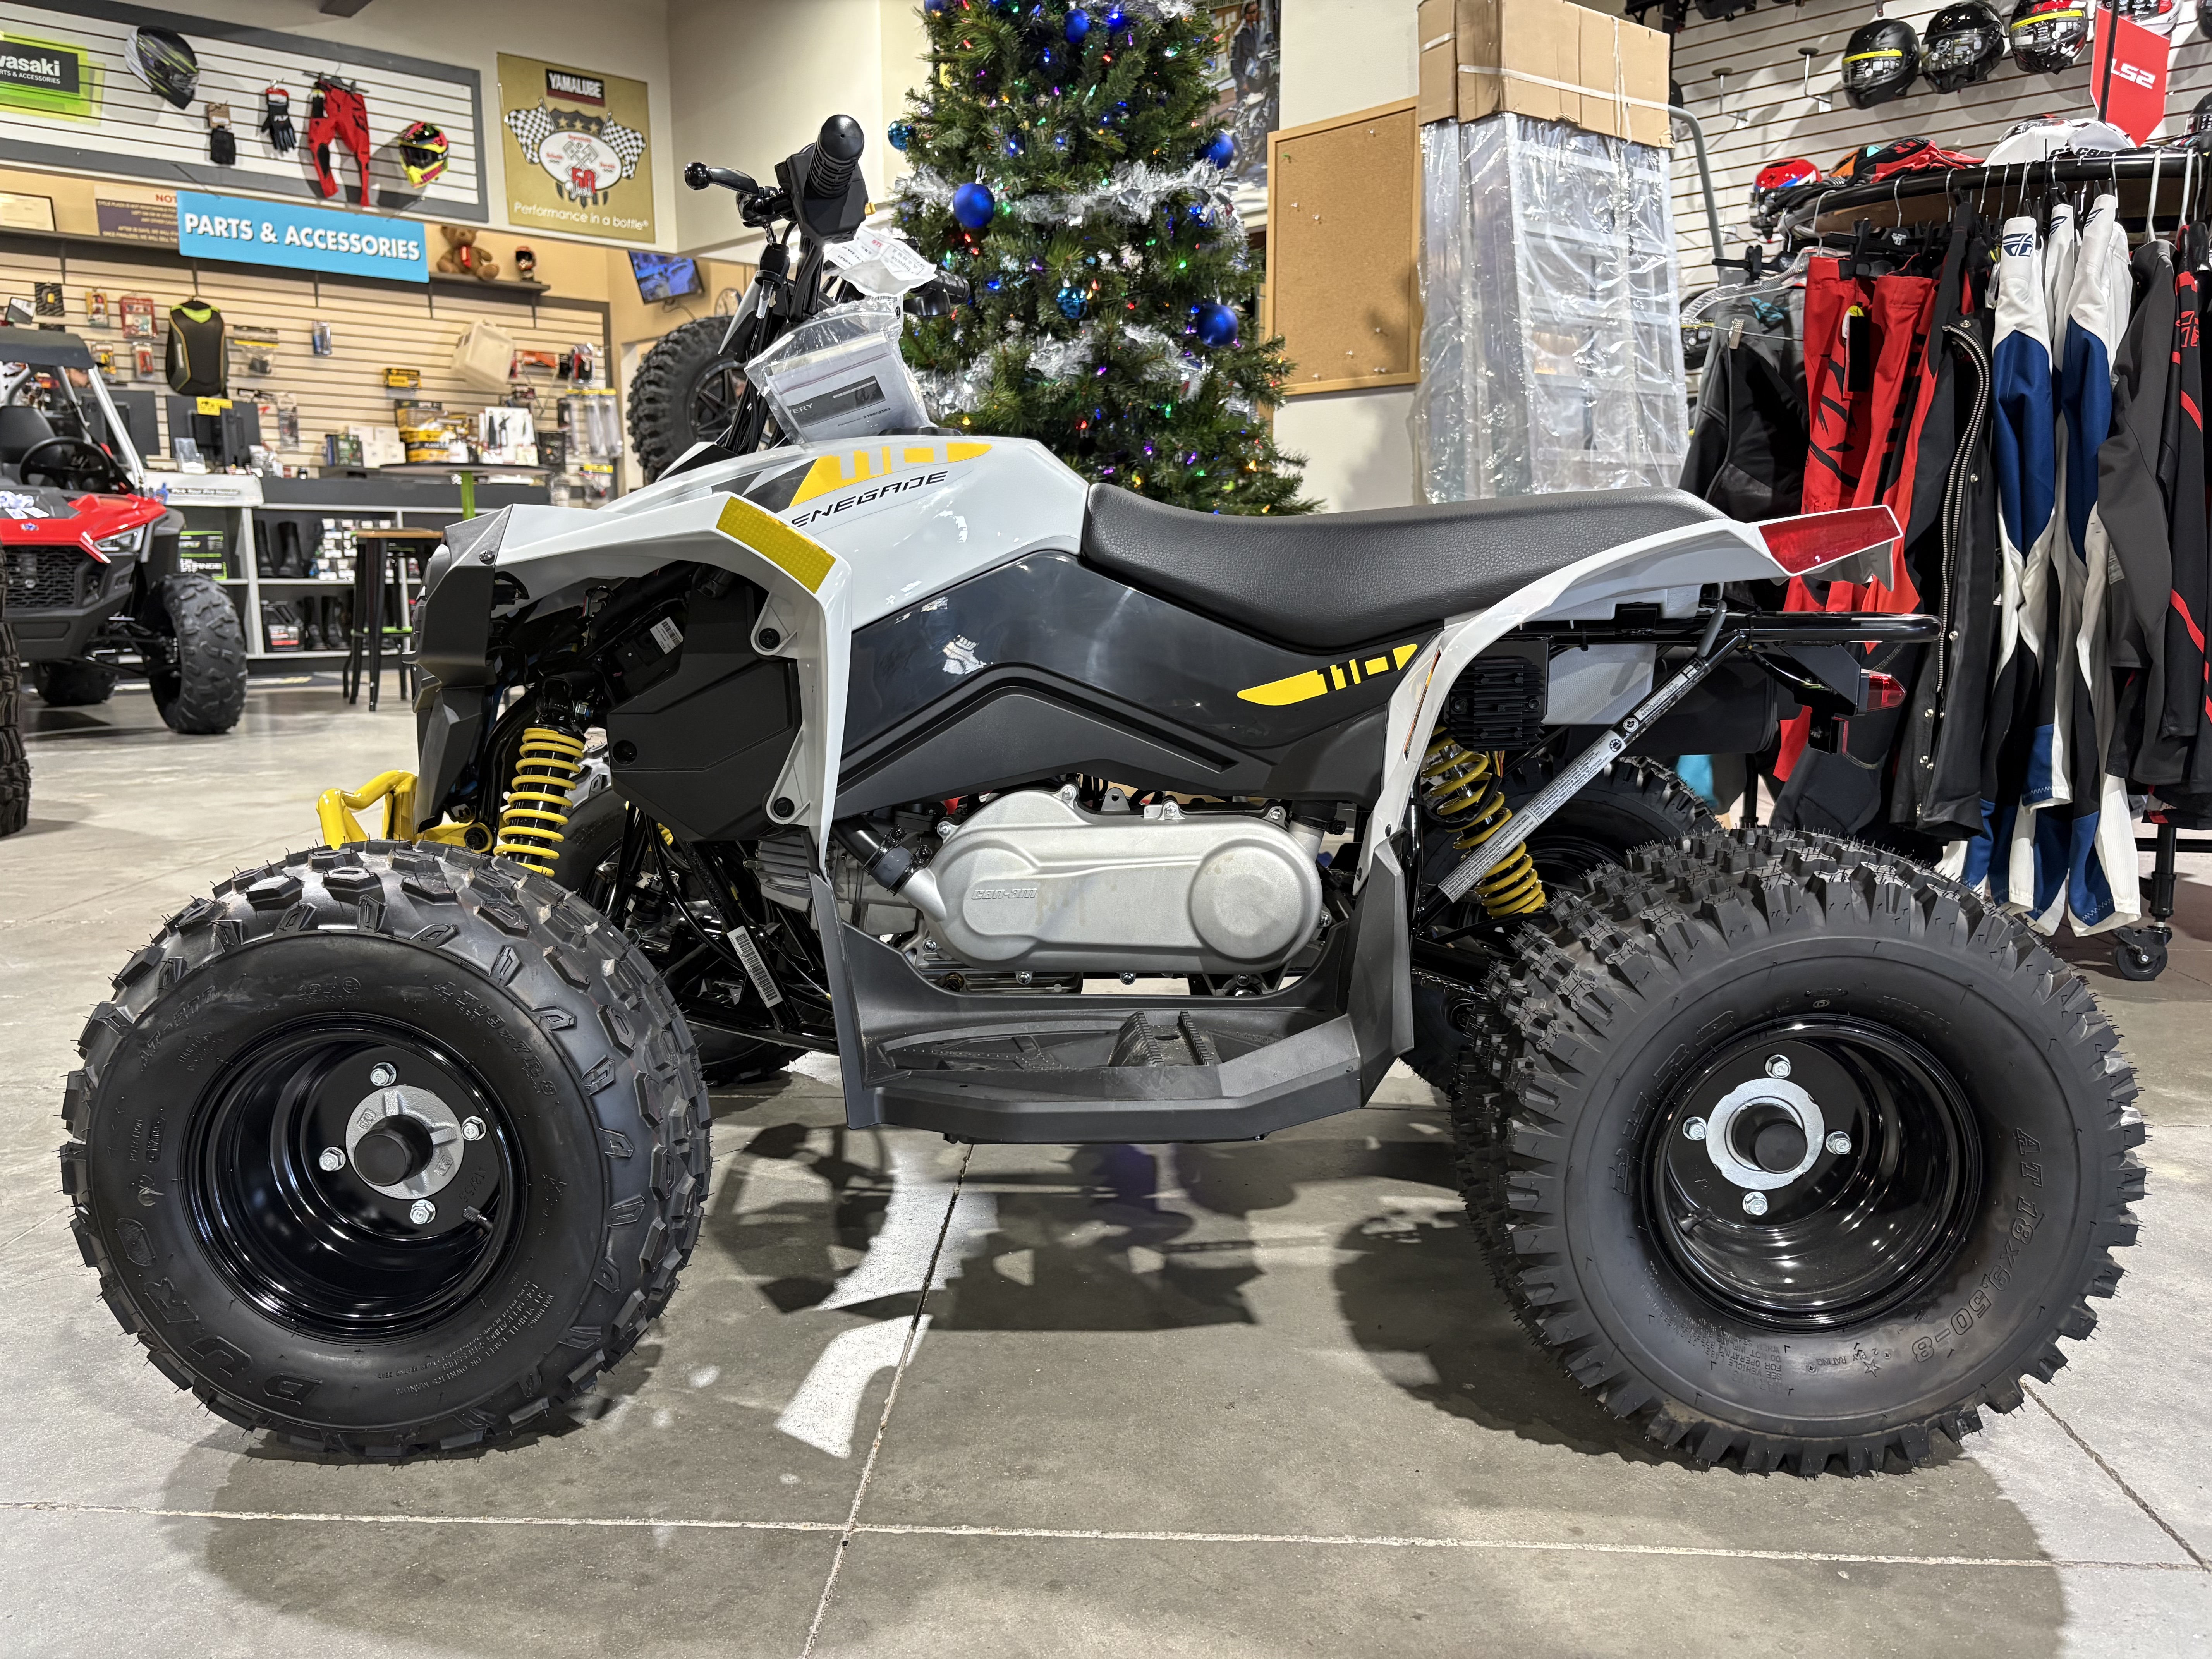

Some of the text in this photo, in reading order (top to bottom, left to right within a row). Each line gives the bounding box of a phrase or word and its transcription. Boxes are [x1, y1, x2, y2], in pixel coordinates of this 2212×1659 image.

[19, 73, 60, 84] ACCESSORIES
[2111, 58, 2156, 89] LS2
[549, 72, 603, 98] YAMALUBE
[514, 202, 610, 225] Performance in a
[185, 213, 421, 261] PARTS & ACCESSORIES
[1317, 649, 1399, 692] 110
[970, 887, 1038, 900] can-am
[2016, 1128, 2043, 1188] AT
[1698, 1344, 1726, 1363] LABEL
[1715, 1344, 1761, 1367] OPERATING
[1748, 1348, 1768, 1360] NOT
[1770, 1354, 1782, 1363] DO
[1816, 1355, 1847, 1366] RATING
[1871, 1347, 1879, 1356] 2
[1726, 1358, 1762, 1376] VEHICLE
[1763, 1361, 1782, 1372] FOR
[1763, 1369, 1782, 1380] SEE
